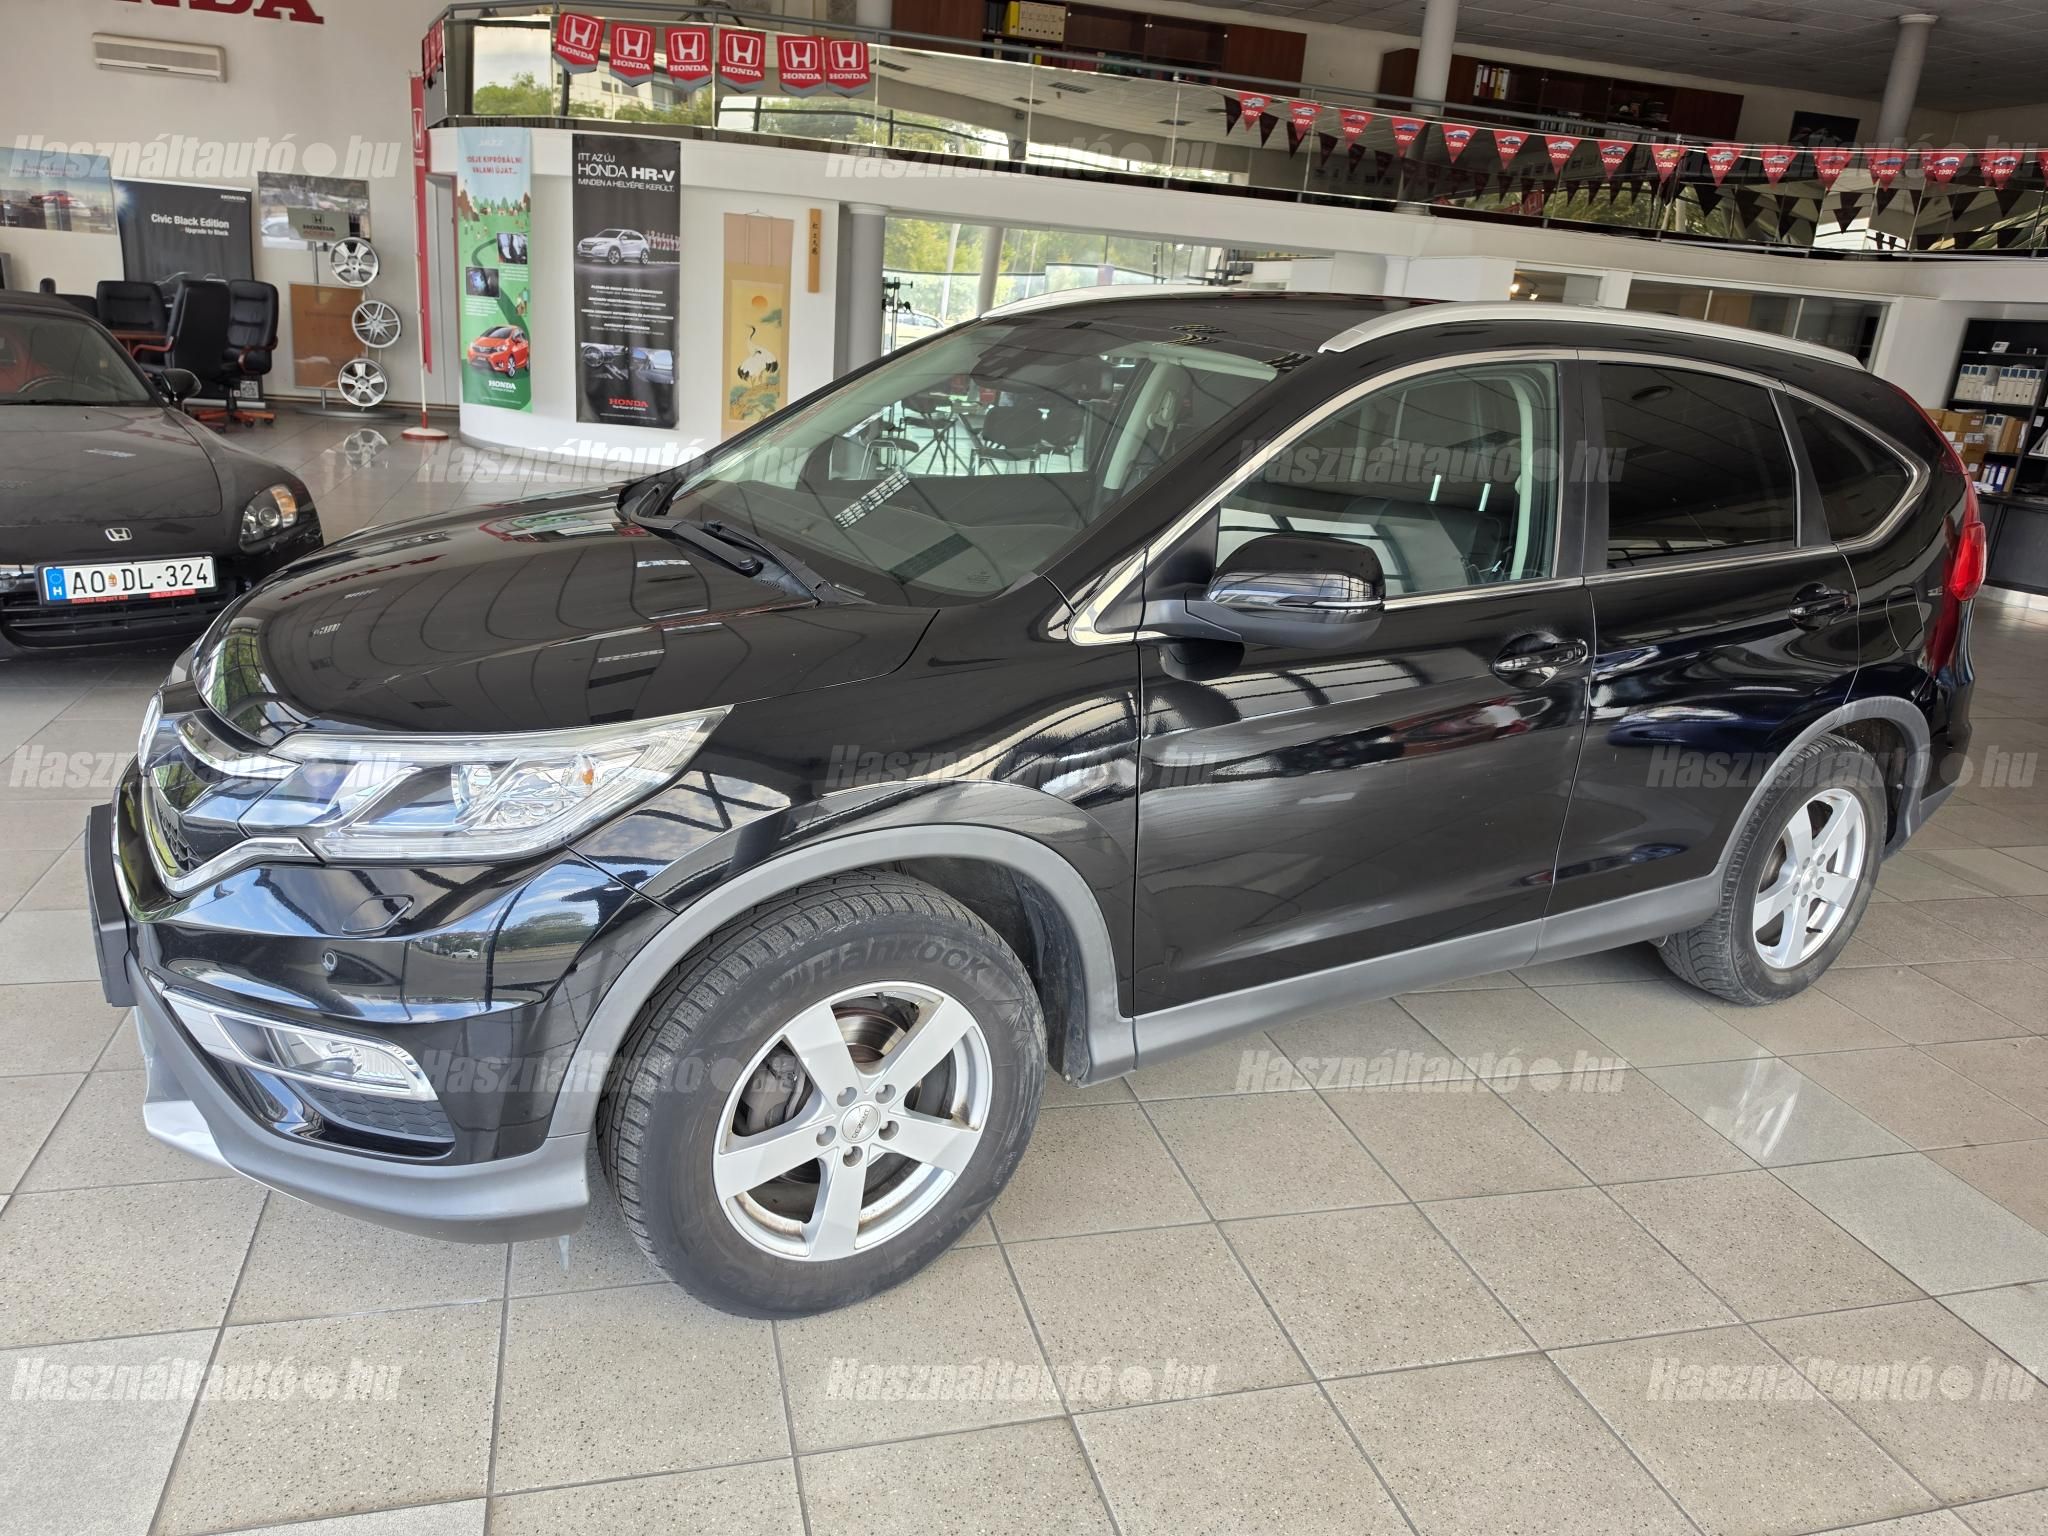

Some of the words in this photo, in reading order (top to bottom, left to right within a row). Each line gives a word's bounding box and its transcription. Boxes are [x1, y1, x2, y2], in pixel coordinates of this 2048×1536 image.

[557, 45, 595, 61] HONDA
[612, 59, 650, 71] HONDA
[721, 65, 761, 77] HONDA
[578, 152, 590, 161] ITT
[591, 153, 603, 162] AZ
[604, 152, 615, 163] ÚJ
[577, 163, 628, 179] HONDA
[631, 166, 675, 183] HR-V
[578, 178, 606, 187] MINDEN
[612, 180, 645, 190] HELYÉRE
[151, 213, 172, 224] Civic
[174, 215, 198, 226] Black
[200, 217, 229, 229] Edition
[488, 379, 517, 390] HONDA
[609, 398, 649, 408] HONDA
[72, 570, 106, 595] AO
[121, 562, 208, 591] DL-324
[53, 587, 62, 596] H
